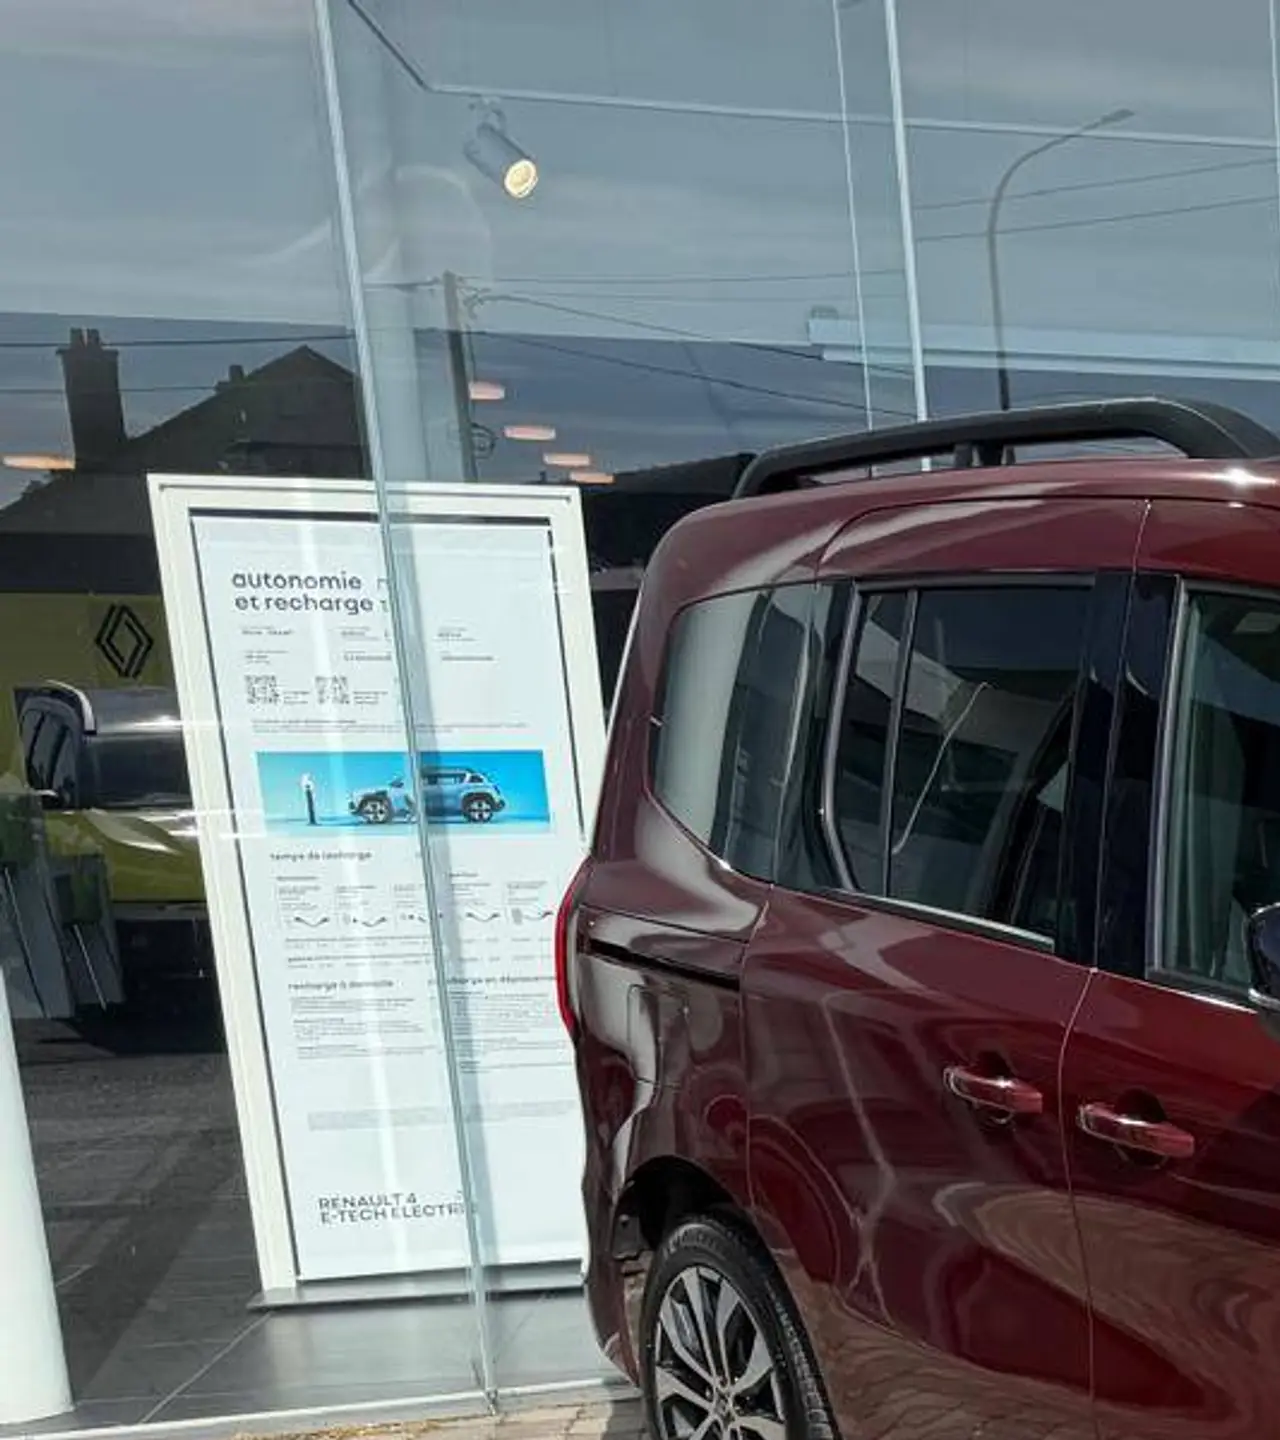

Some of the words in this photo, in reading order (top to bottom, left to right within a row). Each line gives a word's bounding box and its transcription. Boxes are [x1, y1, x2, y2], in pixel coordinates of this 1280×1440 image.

[231, 571, 362, 589] autonomie
[235, 595, 261, 611] et
[265, 594, 374, 615] recharge
[319, 1193, 403, 1210] RENAULT
[320, 1206, 387, 1225] E-TECH
